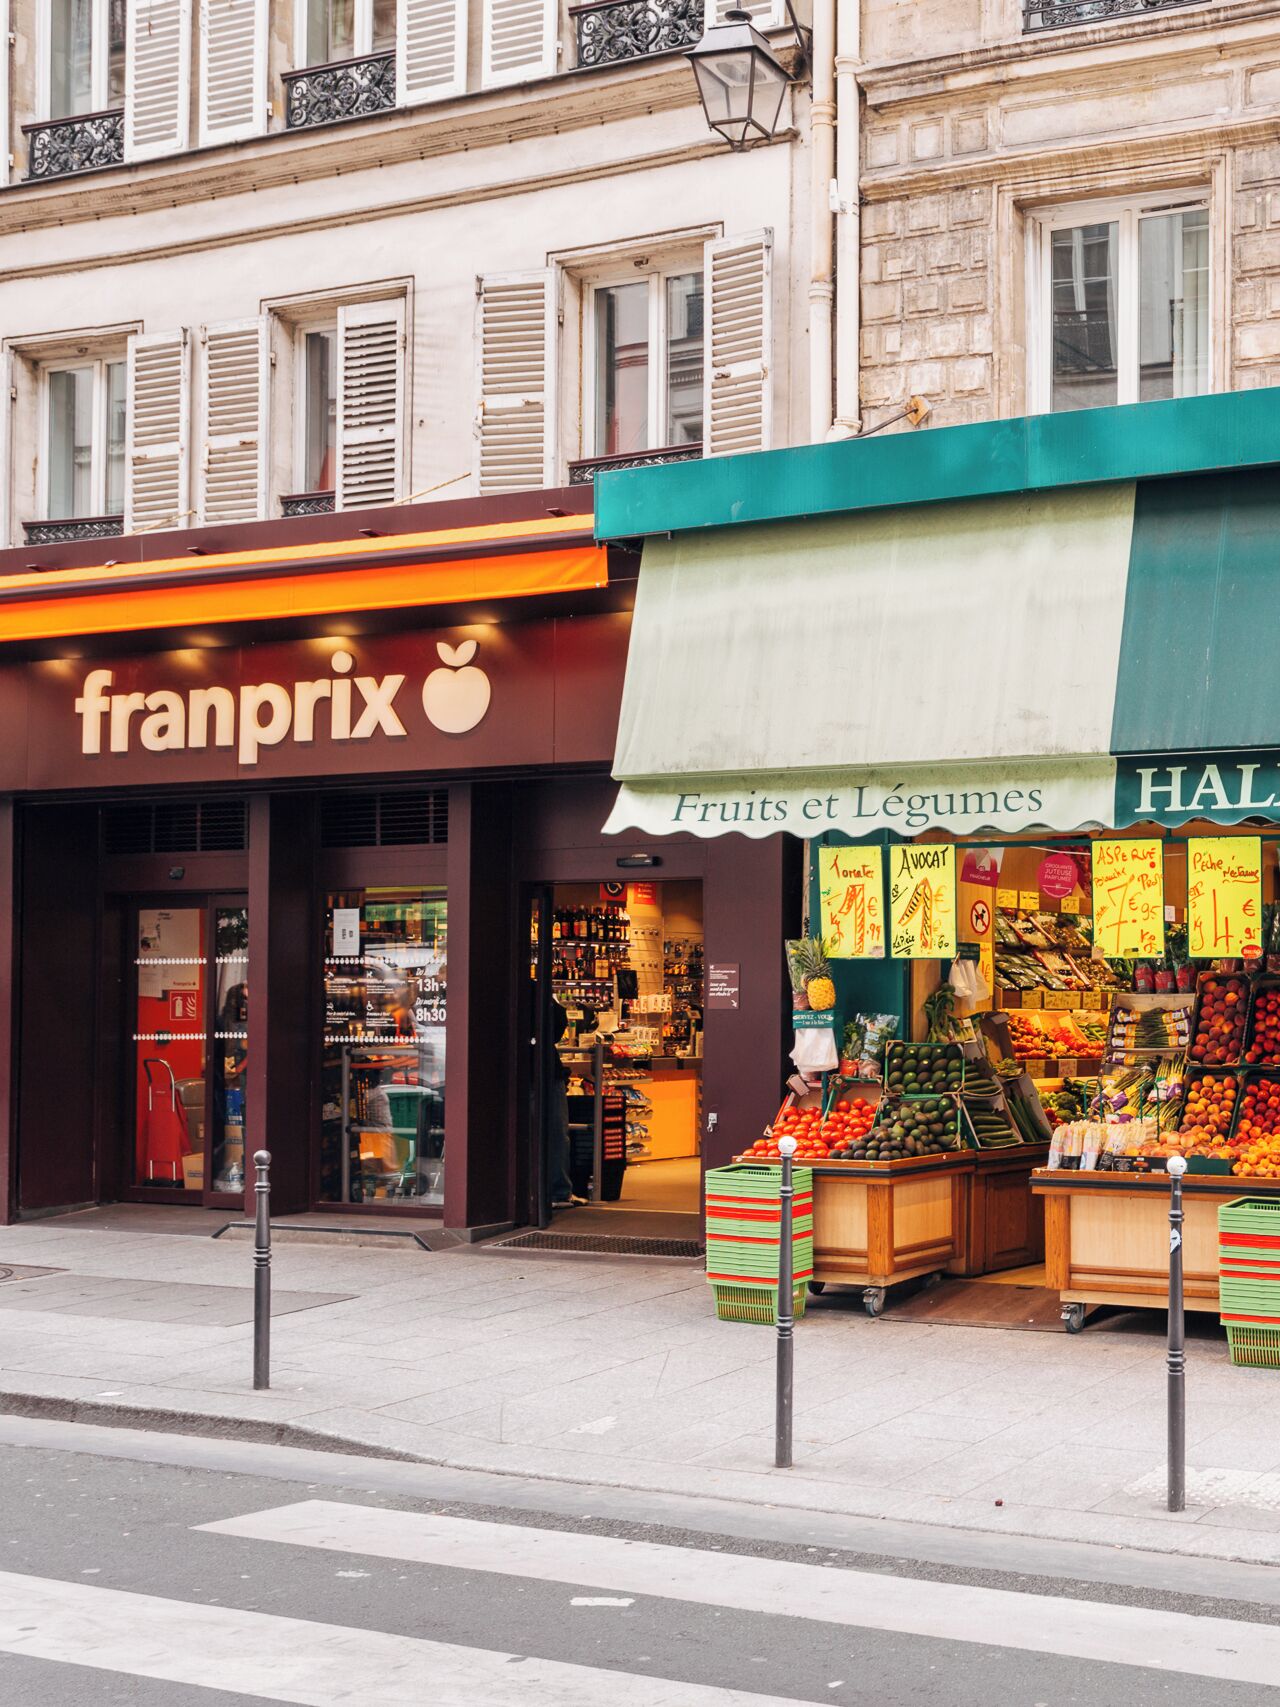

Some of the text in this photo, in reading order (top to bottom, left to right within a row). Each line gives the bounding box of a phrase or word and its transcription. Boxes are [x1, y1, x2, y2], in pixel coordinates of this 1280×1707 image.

[74, 650, 408, 765] franprix
[670, 783, 1044, 828] Fruits et Légumes
[416, 978, 439, 992] 13h
[416, 1007, 447, 1022] 8h30
